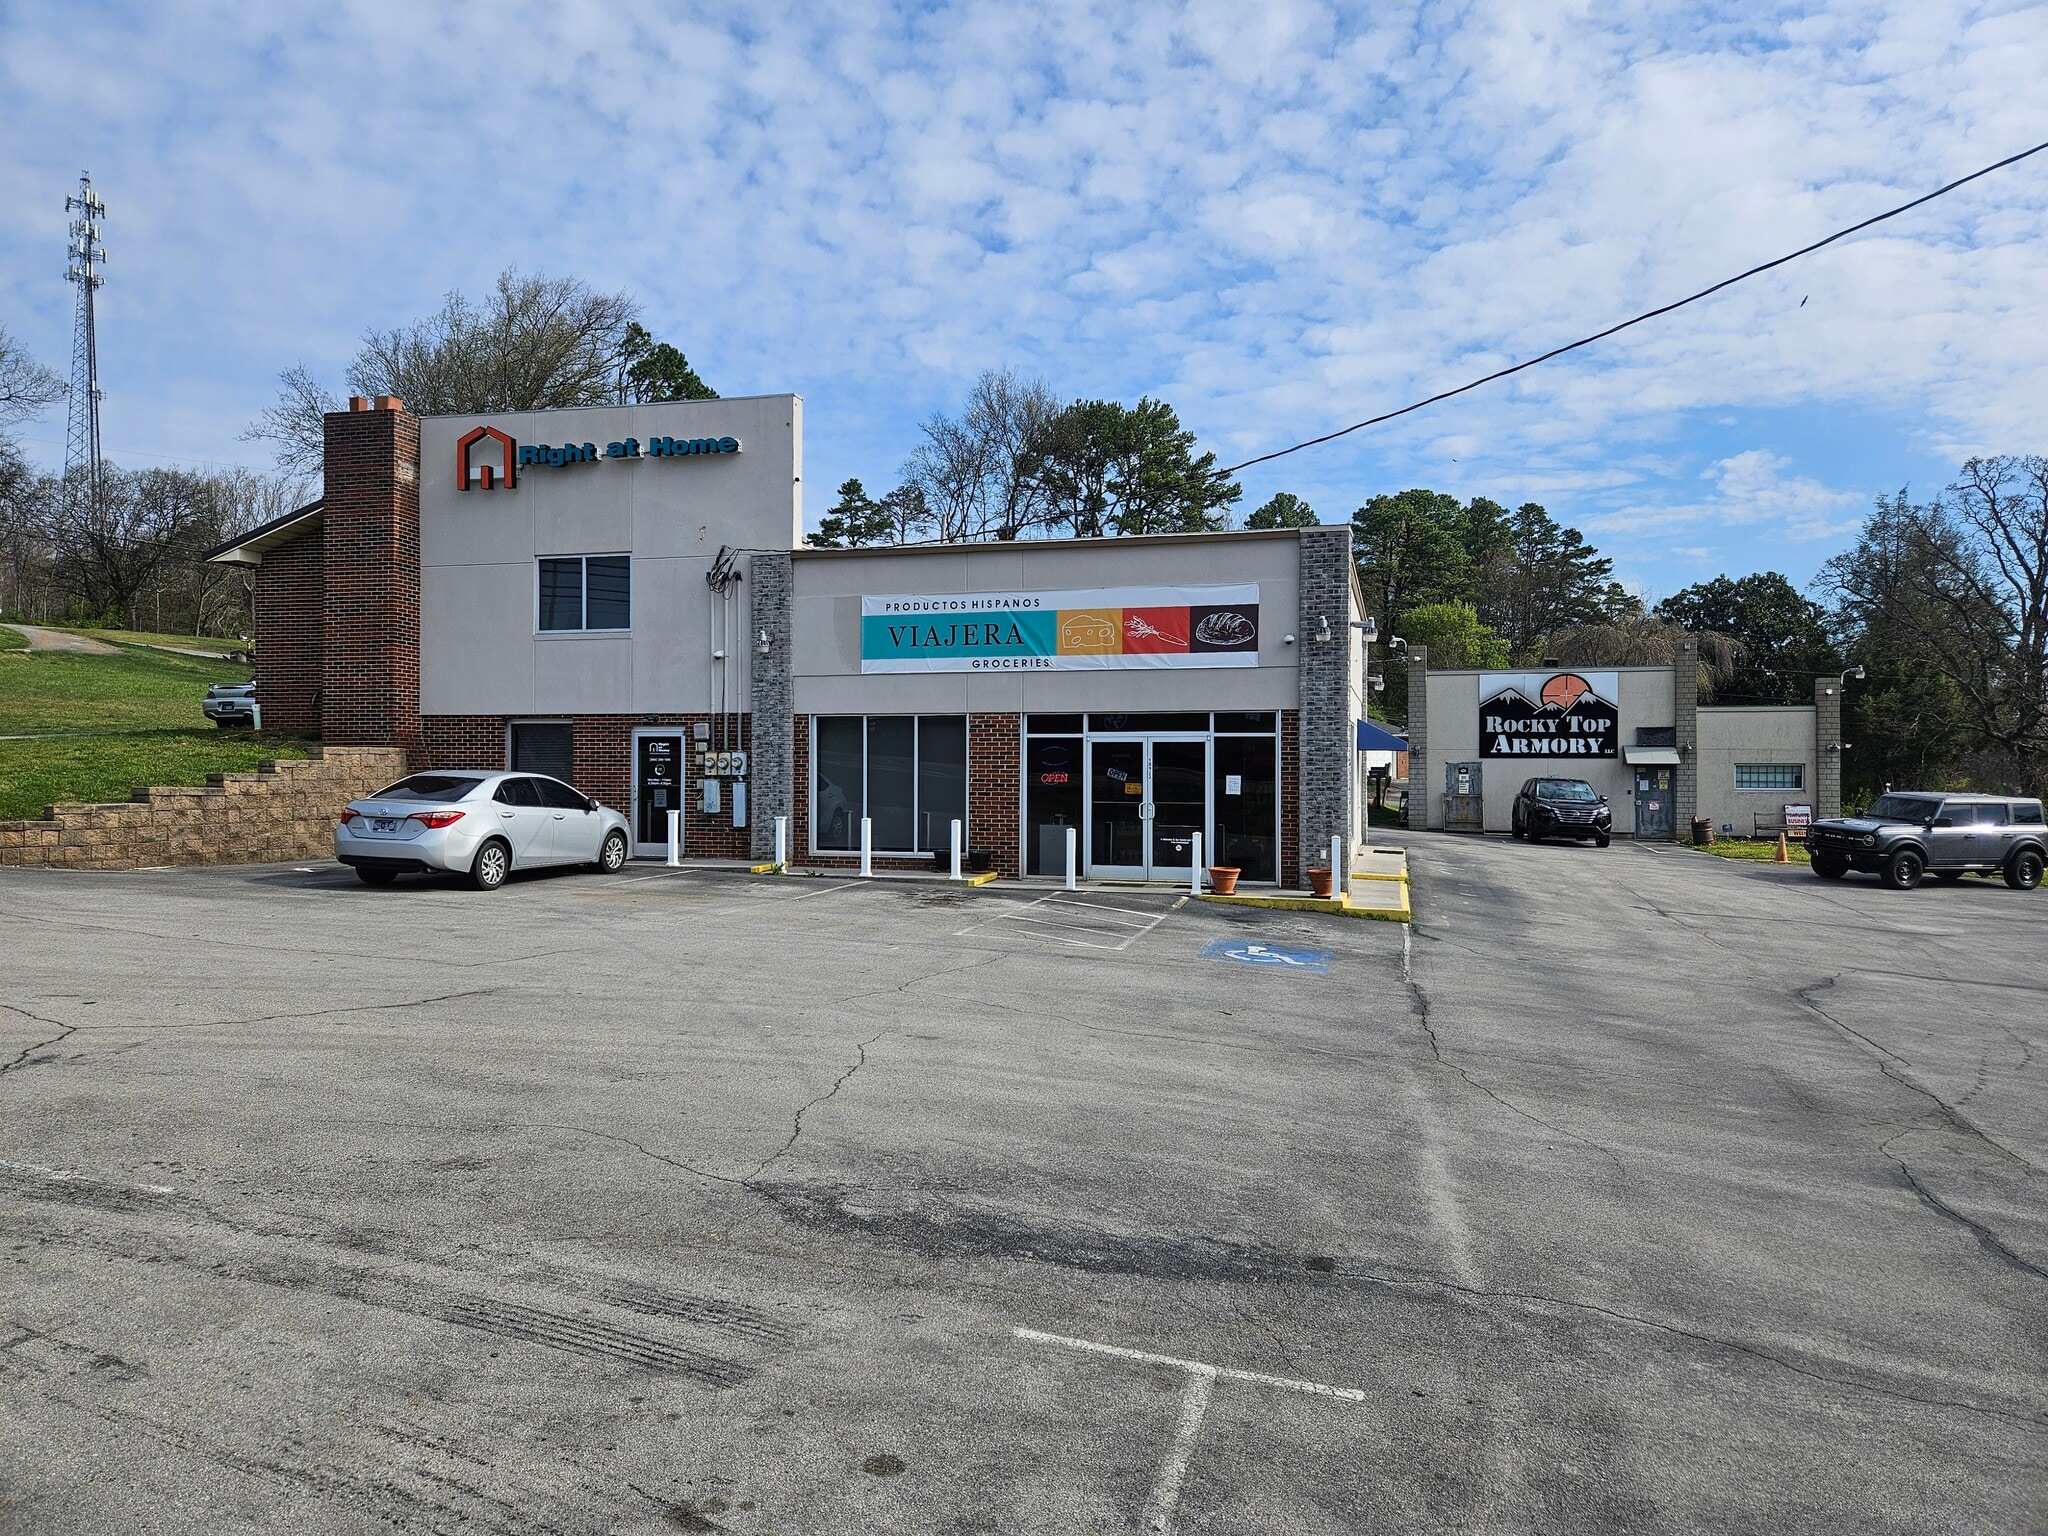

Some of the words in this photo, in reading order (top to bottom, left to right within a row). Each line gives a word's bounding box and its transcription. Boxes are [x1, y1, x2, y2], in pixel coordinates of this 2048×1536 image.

[519, 442, 598, 467] Right
[606, 438, 638, 457] at
[650, 436, 739, 457] Home
[885, 601, 967, 612] PRODUCTOS
[971, 598, 1040, 609] HISPANOS
[888, 622, 1025, 648] VIAJERA
[972, 658, 1050, 669] GROCERIES
[1485, 715, 1560, 733] ROCKY
[1566, 715, 1611, 733] TOP
[1490, 734, 1604, 754] ARMORY
[1040, 773, 1069, 783] OPEN
[1109, 769, 1126, 780] OPEN
